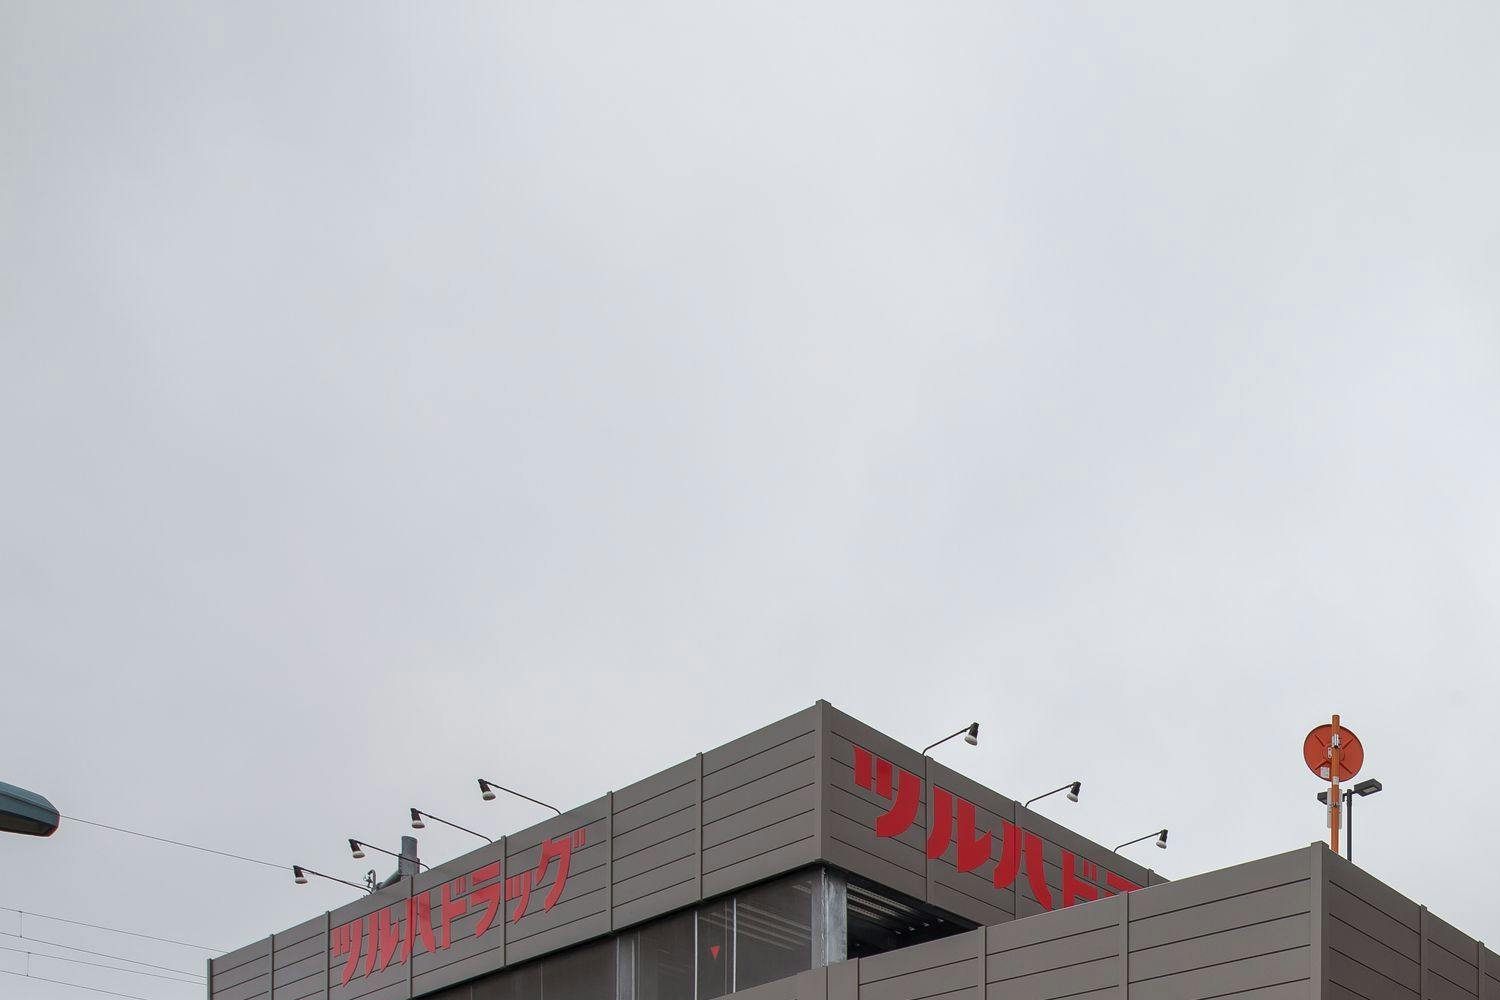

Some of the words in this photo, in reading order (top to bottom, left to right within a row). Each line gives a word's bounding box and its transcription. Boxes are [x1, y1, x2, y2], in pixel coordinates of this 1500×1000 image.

[332, 828, 586, 988] ツルハドラッグ
